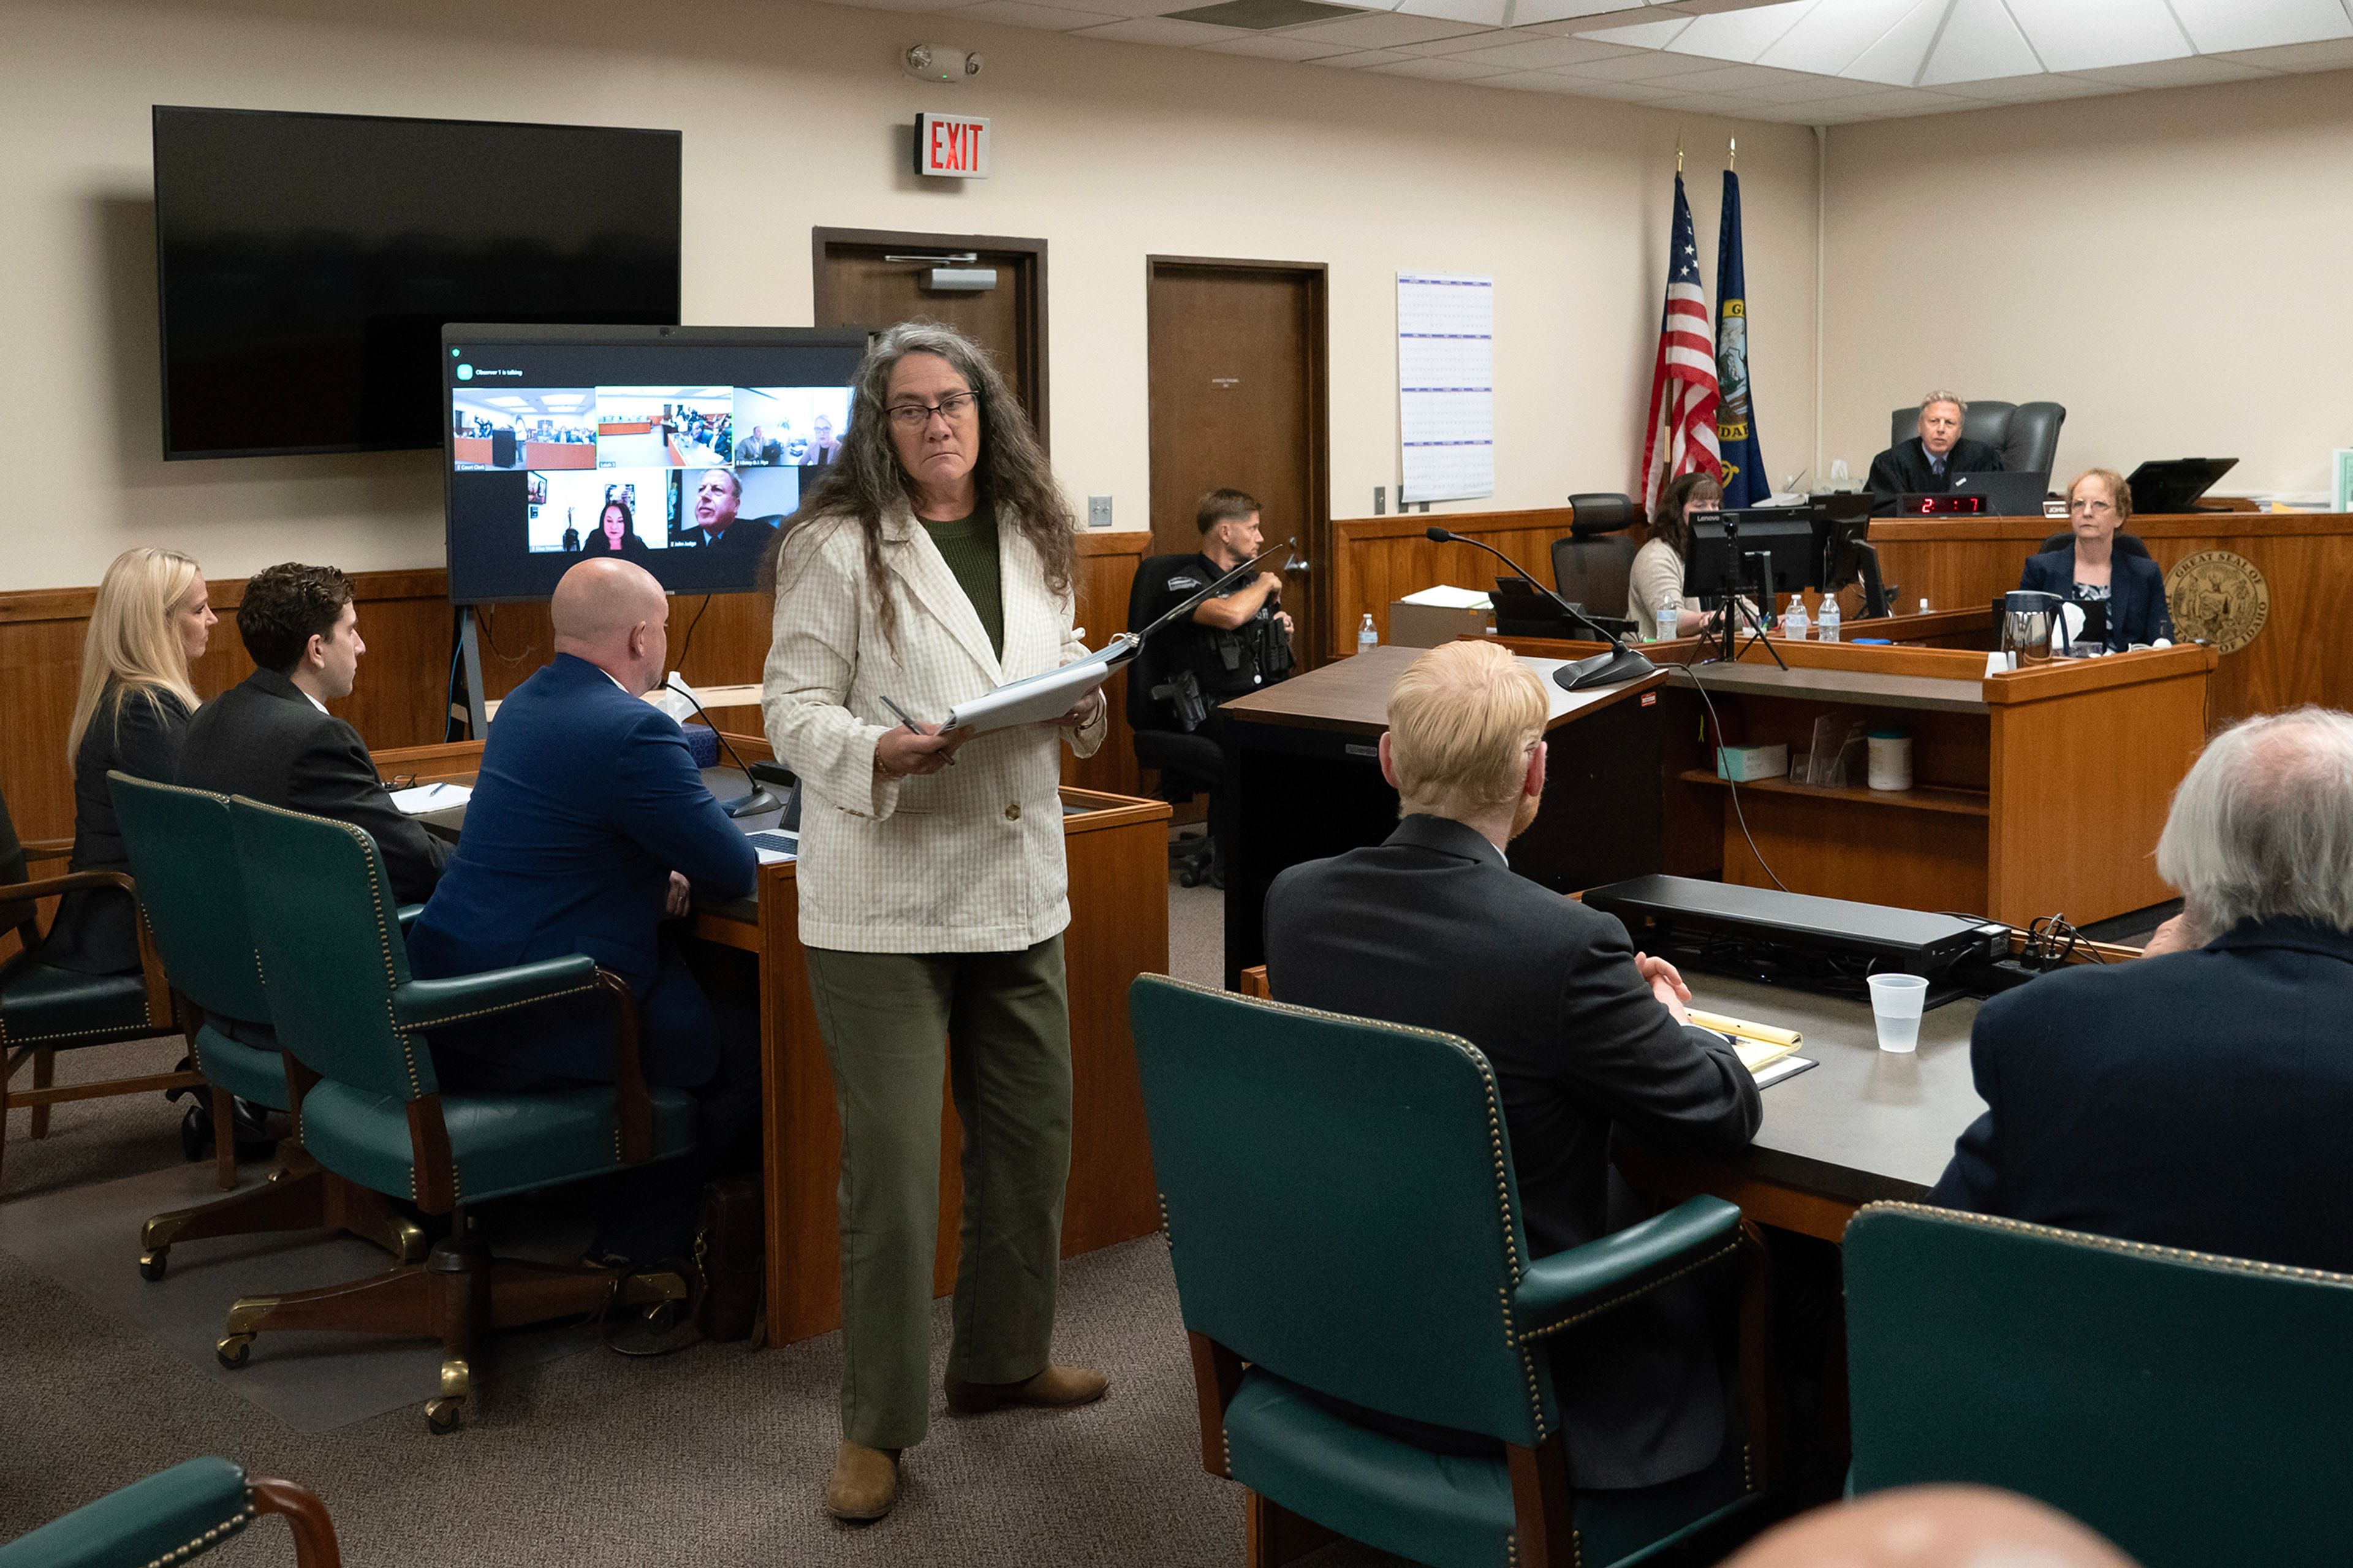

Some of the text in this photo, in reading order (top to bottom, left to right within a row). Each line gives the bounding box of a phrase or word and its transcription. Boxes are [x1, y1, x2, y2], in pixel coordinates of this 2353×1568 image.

[931, 121, 983, 172] EXIT
[2175, 553, 2262, 584] GREAT SEAL OF
[2219, 601, 2267, 652] OF IDAHO
